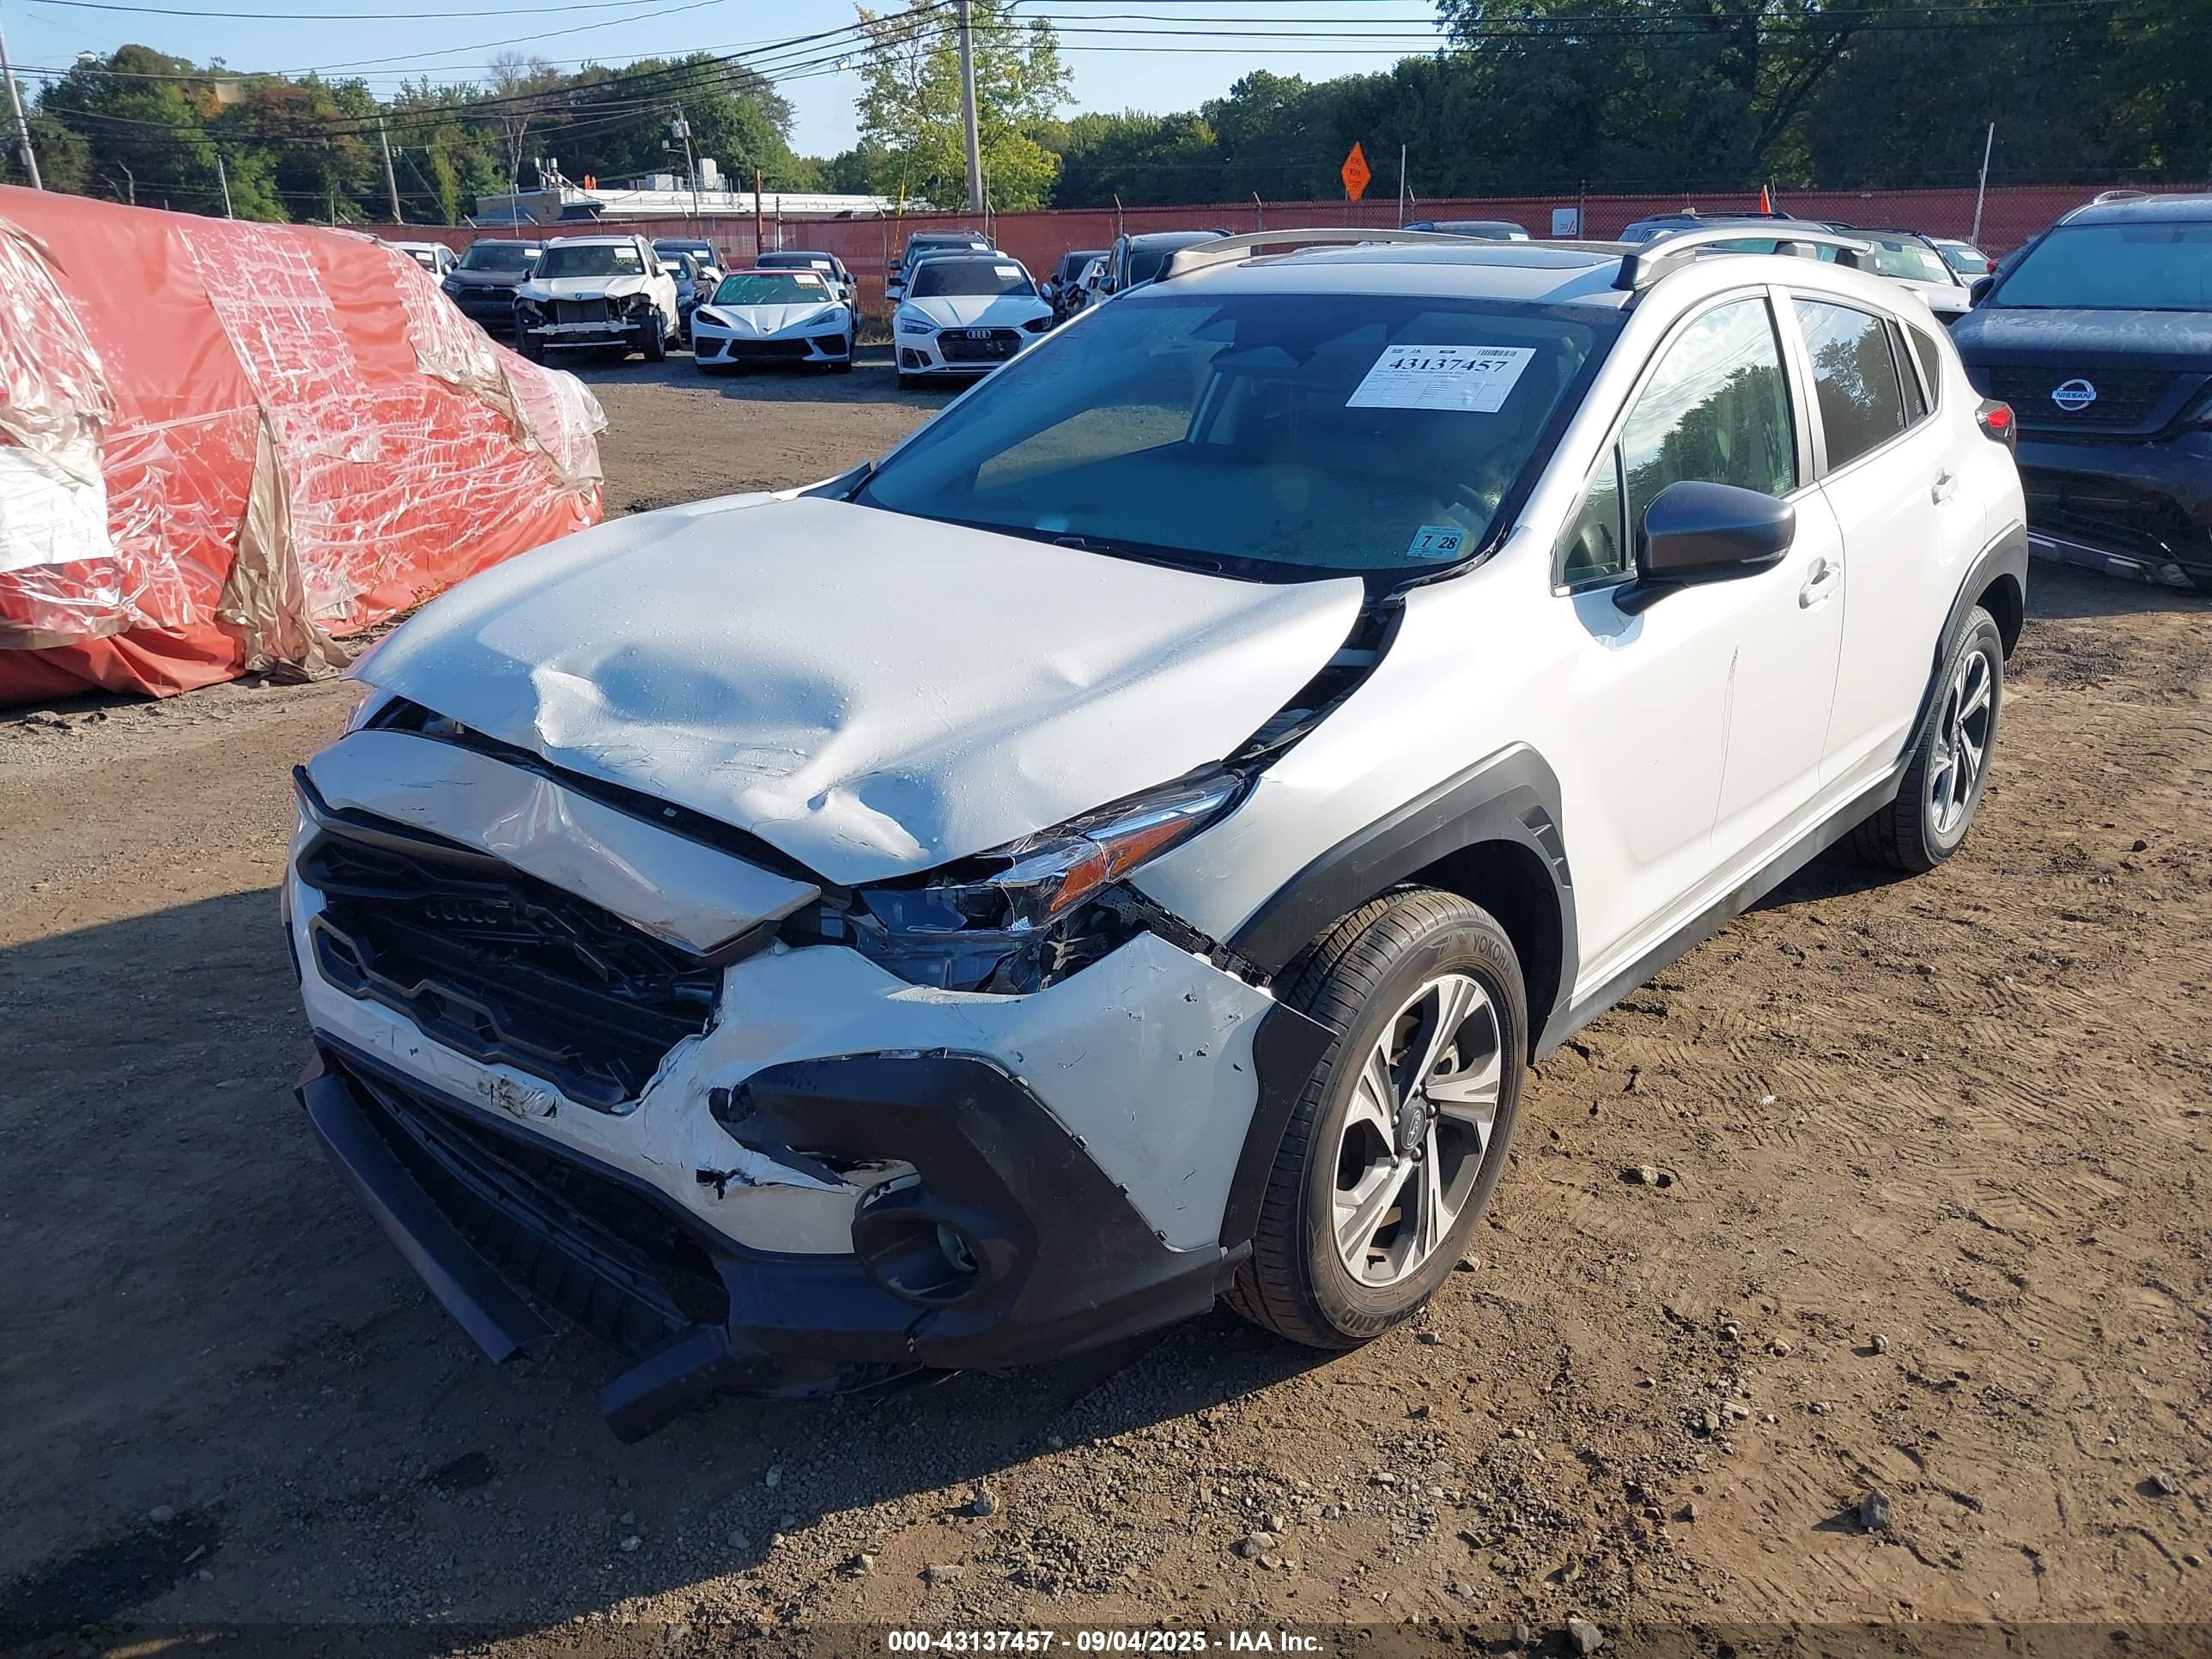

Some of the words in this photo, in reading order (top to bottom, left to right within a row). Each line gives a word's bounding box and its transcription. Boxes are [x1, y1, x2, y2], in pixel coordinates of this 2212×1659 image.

[1389, 357, 1509, 373] 43137457
[1421, 535, 1433, 547] 7
[1438, 537, 1457, 550] 28
